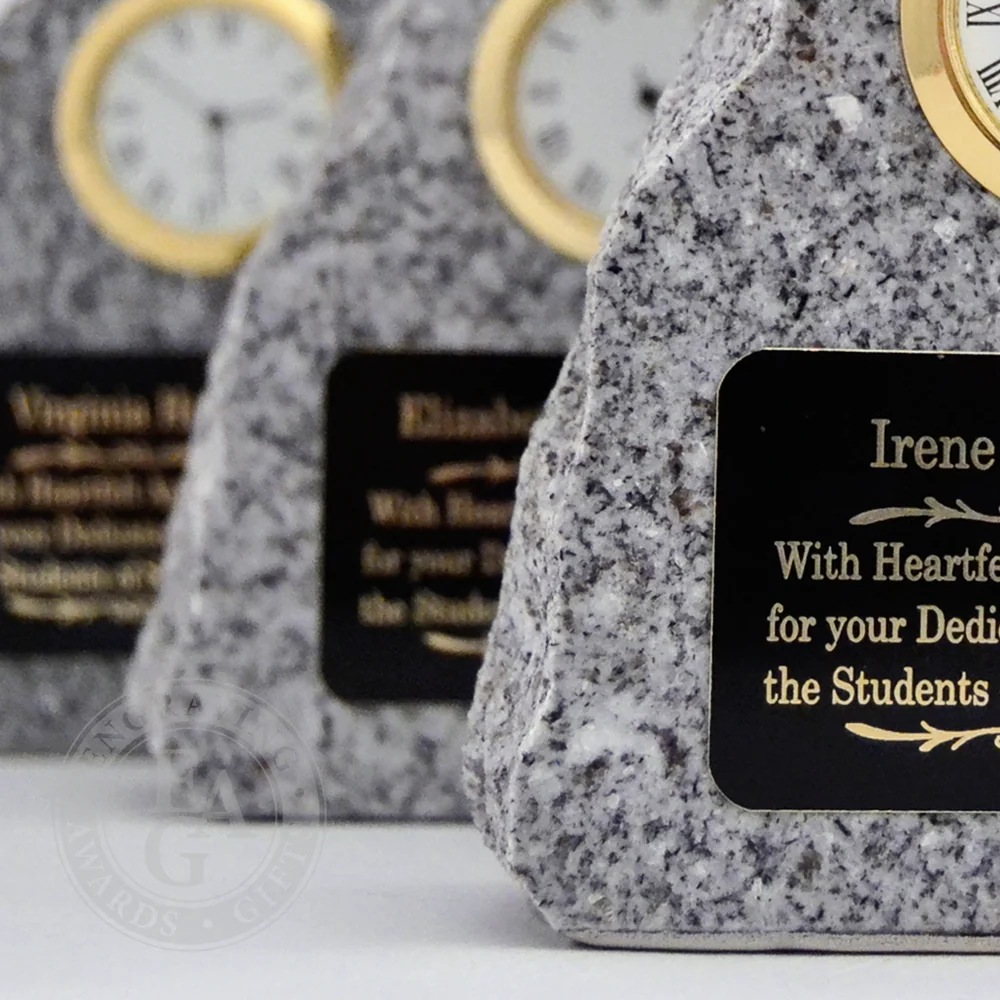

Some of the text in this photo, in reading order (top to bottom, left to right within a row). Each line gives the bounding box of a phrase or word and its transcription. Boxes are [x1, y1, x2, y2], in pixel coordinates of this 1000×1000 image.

[871, 419, 994, 470] Irene
[775, 541, 861, 580] With
[767, 603, 816, 642] for
[825, 616, 906, 651] your
[763, 666, 820, 705] the
[832, 666, 989, 706] Students
